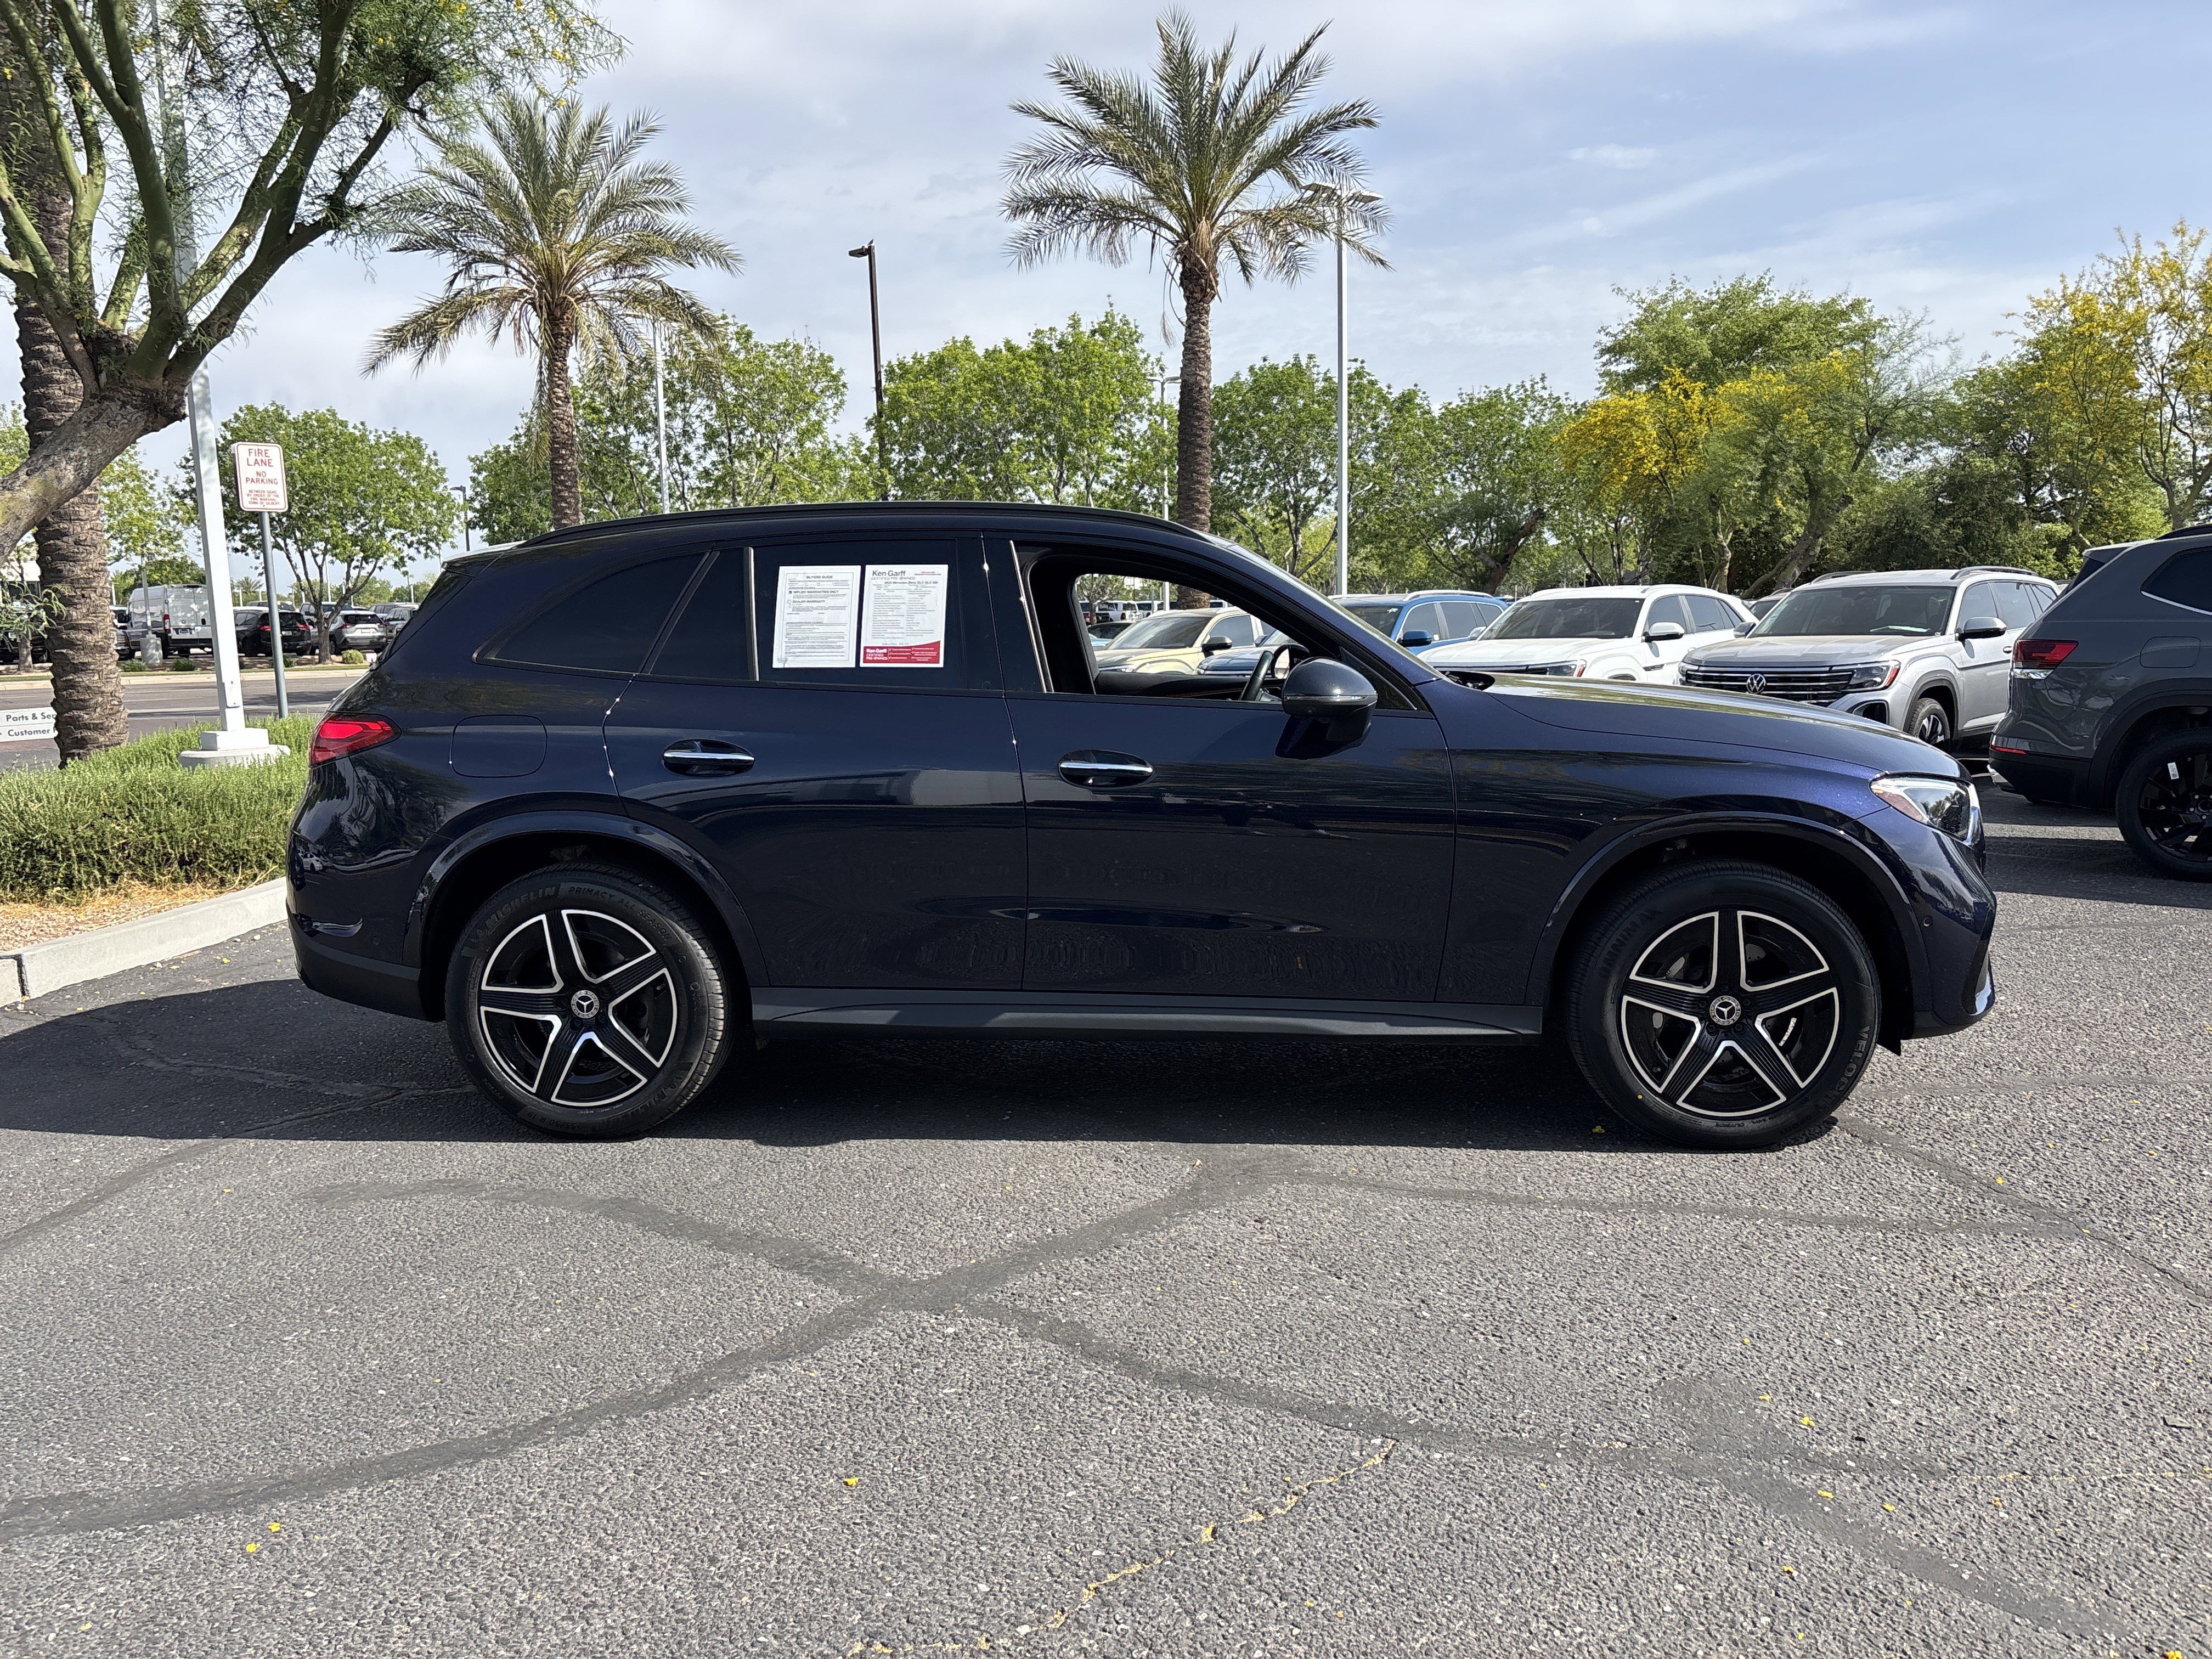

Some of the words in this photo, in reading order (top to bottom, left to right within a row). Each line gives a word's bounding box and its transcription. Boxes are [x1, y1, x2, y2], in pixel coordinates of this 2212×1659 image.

[248, 448, 270, 458] FIRE
[247, 458, 273, 467] LANE
[7, 729, 50, 737] Customer
[485, 886, 557, 931] MICHELIN
[568, 886, 615, 901] PRIMACY
[616, 898, 635, 911] ALL
